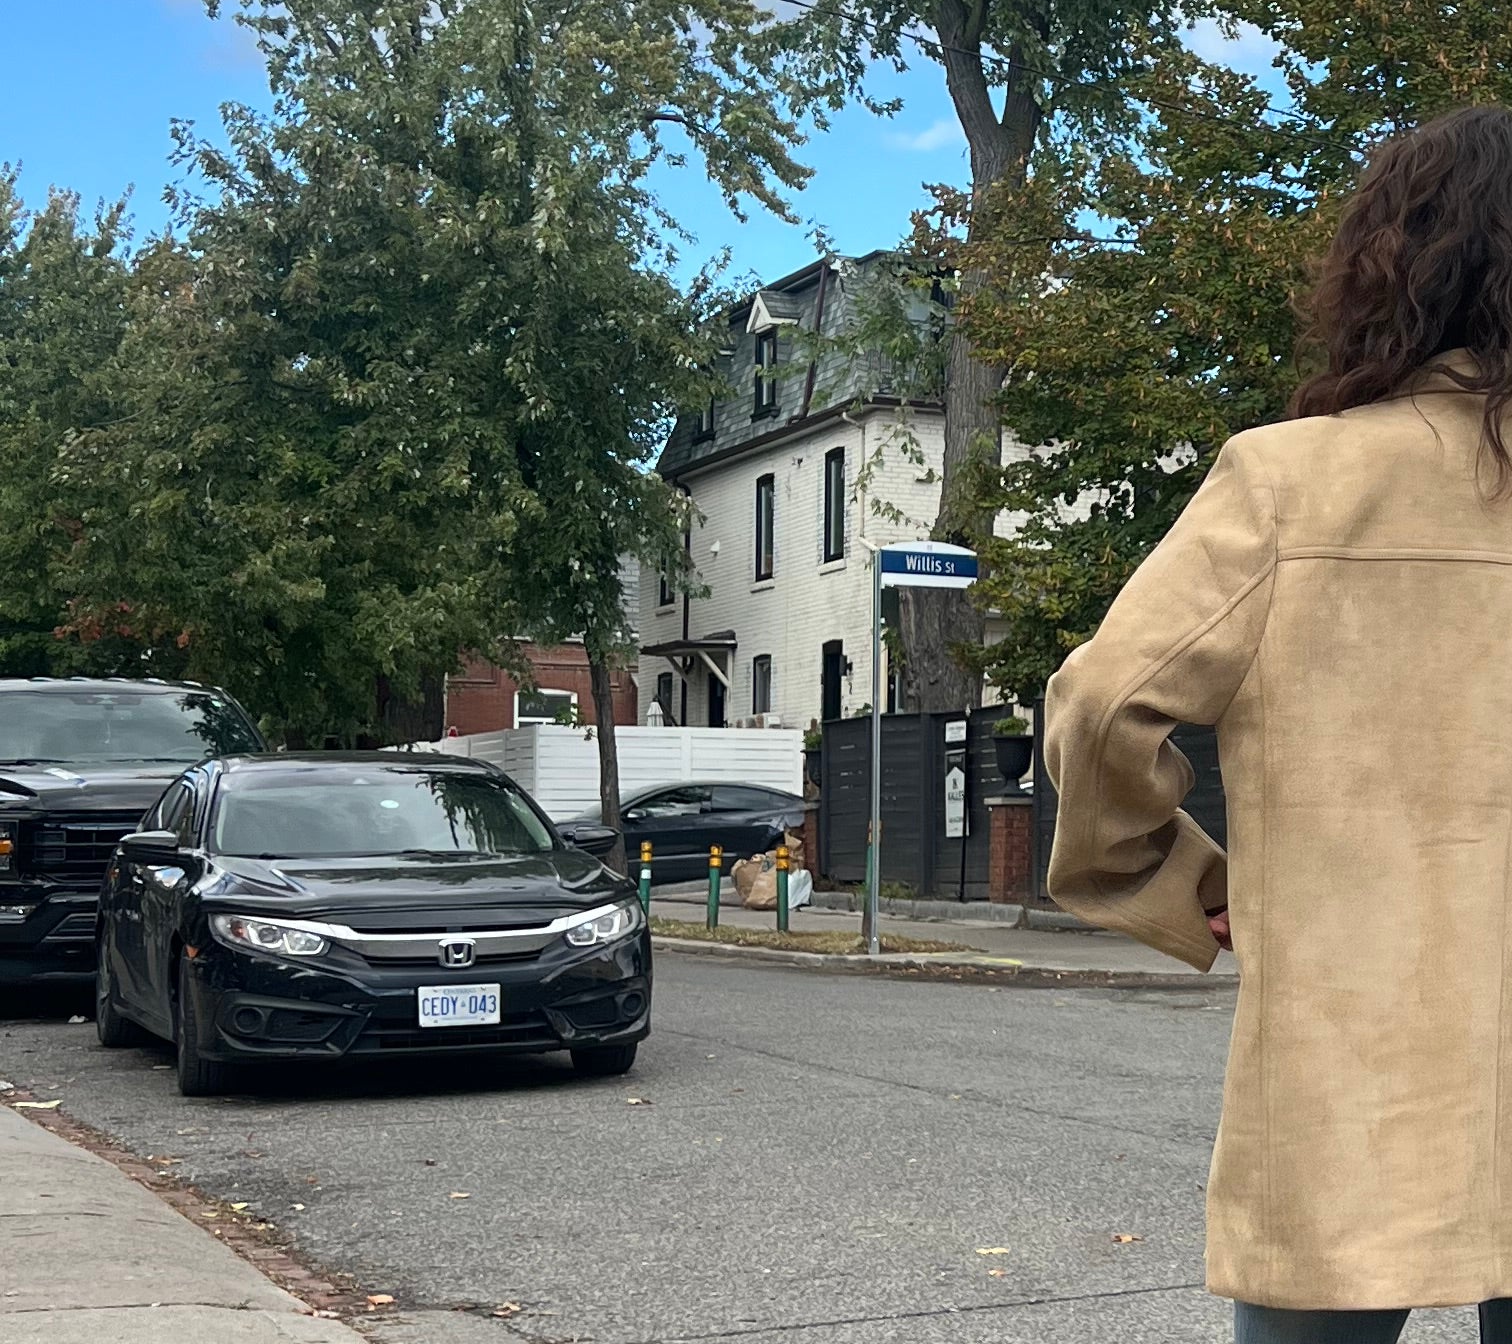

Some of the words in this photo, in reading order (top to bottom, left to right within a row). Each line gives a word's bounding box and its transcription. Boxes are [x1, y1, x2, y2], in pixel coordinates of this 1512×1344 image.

[905, 554, 943, 573] Willis
[945, 561, 955, 574] St
[422, 996, 458, 1016] CEDY
[469, 994, 497, 1014] 043
